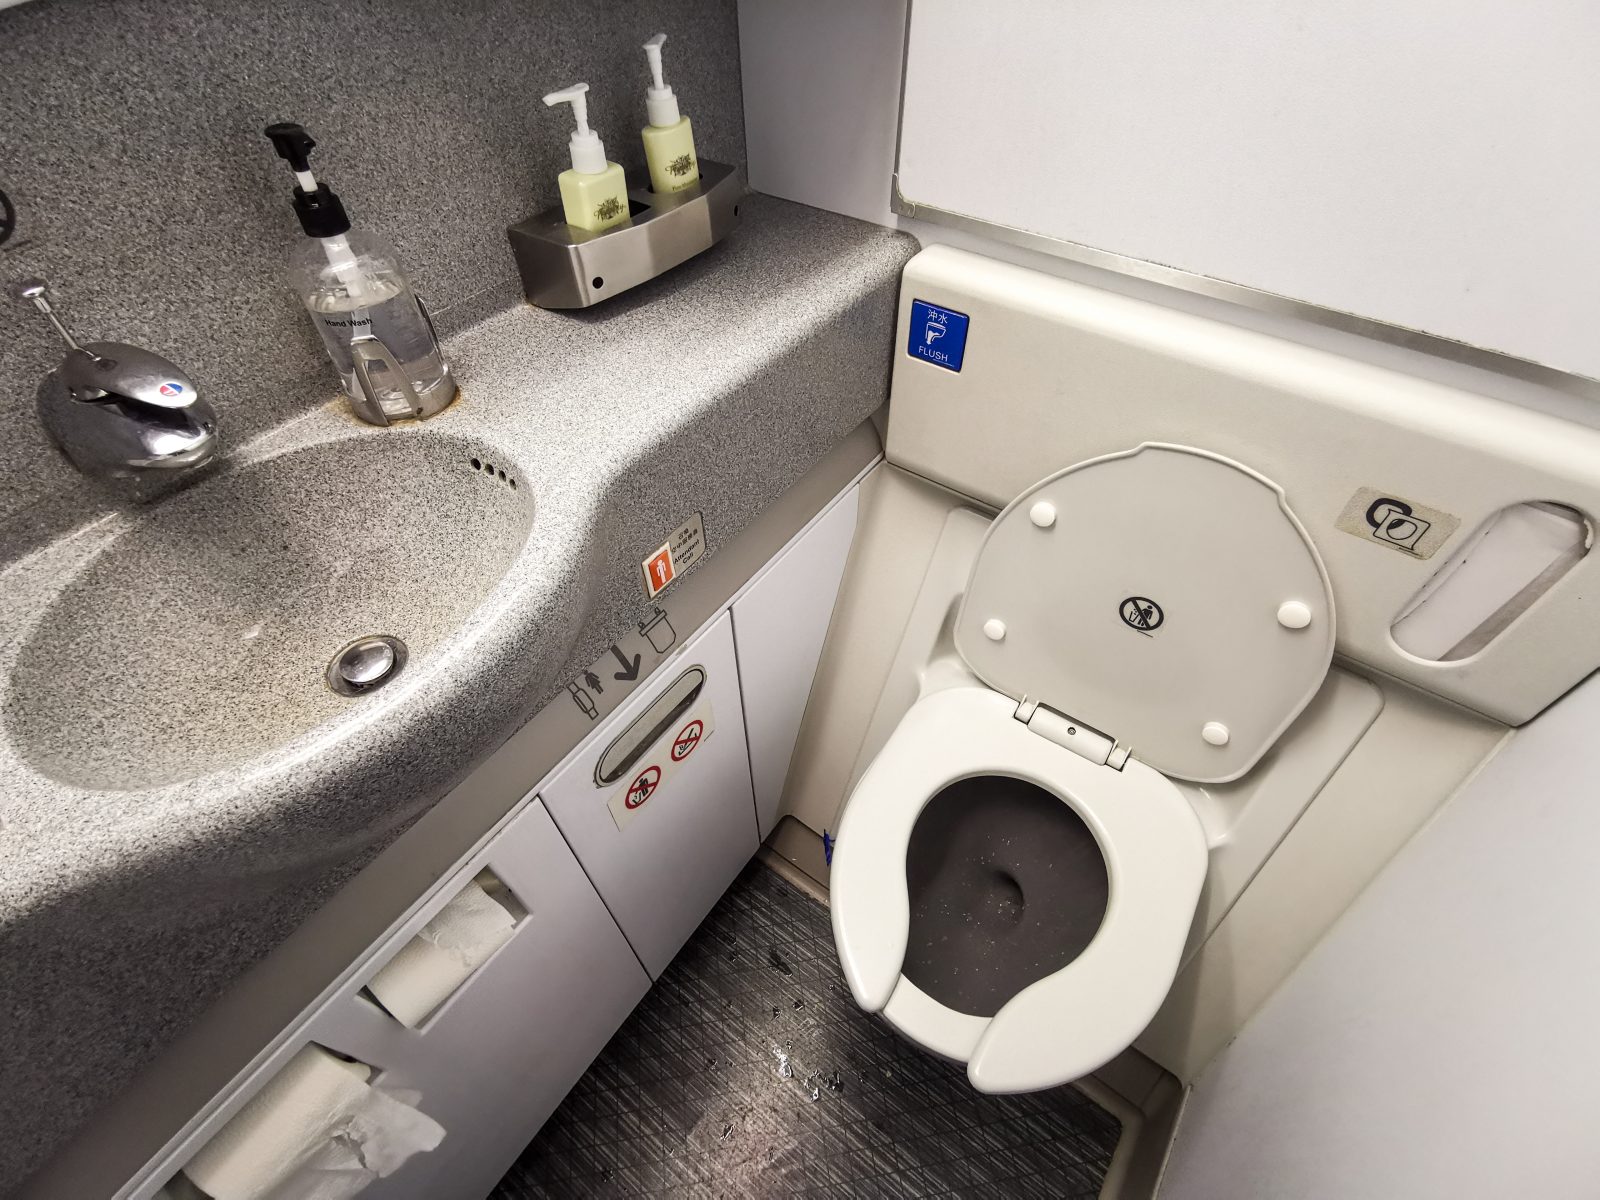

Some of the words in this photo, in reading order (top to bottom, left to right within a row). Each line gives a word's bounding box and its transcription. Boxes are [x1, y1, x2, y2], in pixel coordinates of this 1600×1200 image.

[325, 319, 347, 327] Hand
[347, 317, 373, 327] Wash
[918, 345, 949, 362] FLUSH
[674, 539, 700, 564] Attendant
[682, 552, 694, 564] Call
